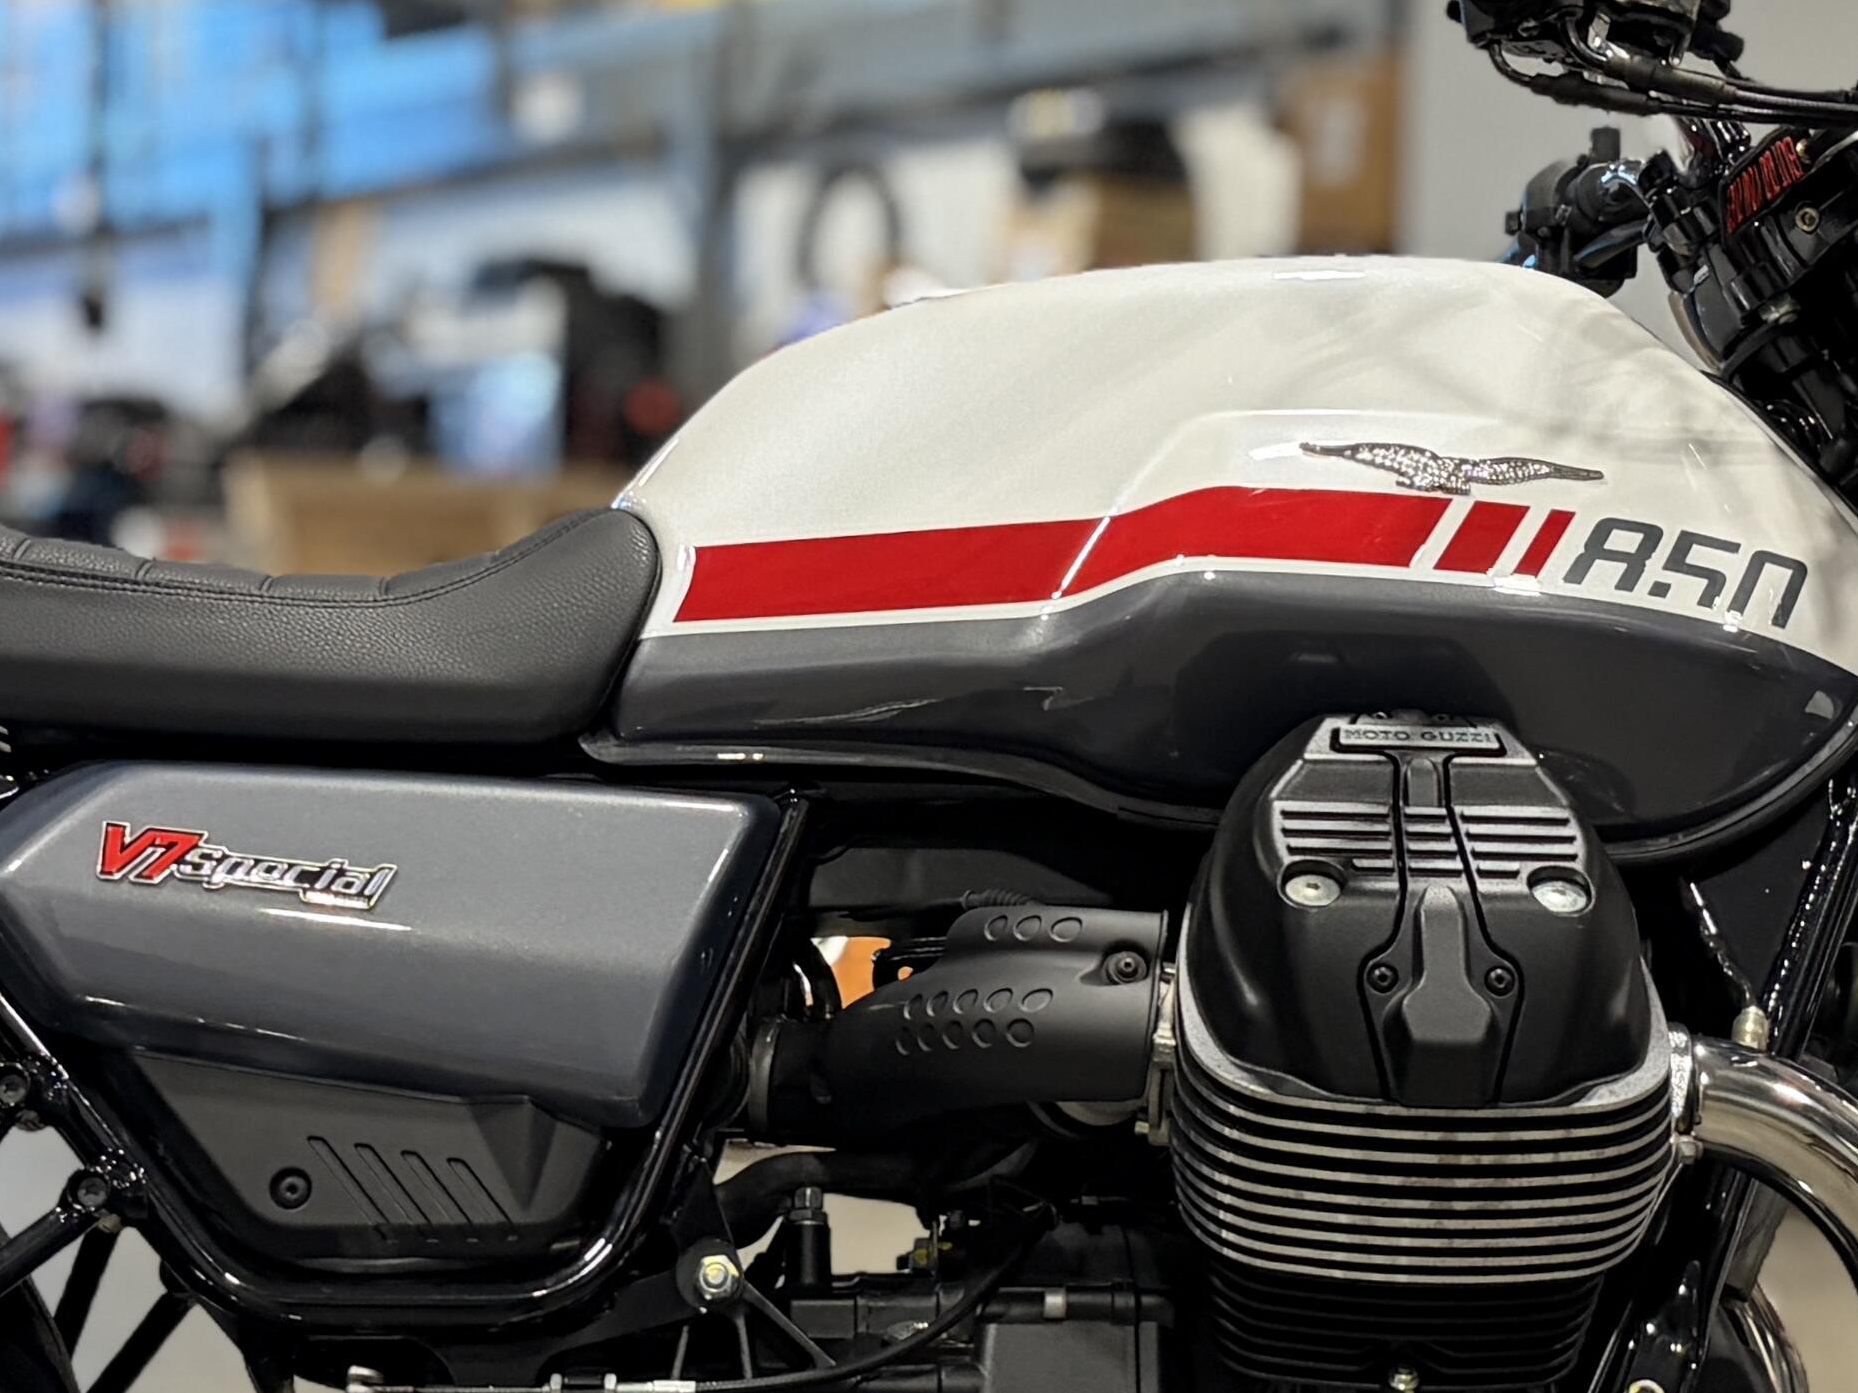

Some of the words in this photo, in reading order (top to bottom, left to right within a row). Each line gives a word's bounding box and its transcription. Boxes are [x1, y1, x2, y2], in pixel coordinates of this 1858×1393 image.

[1562, 516, 1808, 628] 850
[1344, 729, 1409, 741] MOTO
[1421, 731, 1492, 744] GUZZI
[98, 822, 207, 883] V7
[175, 847, 397, 899] Special
